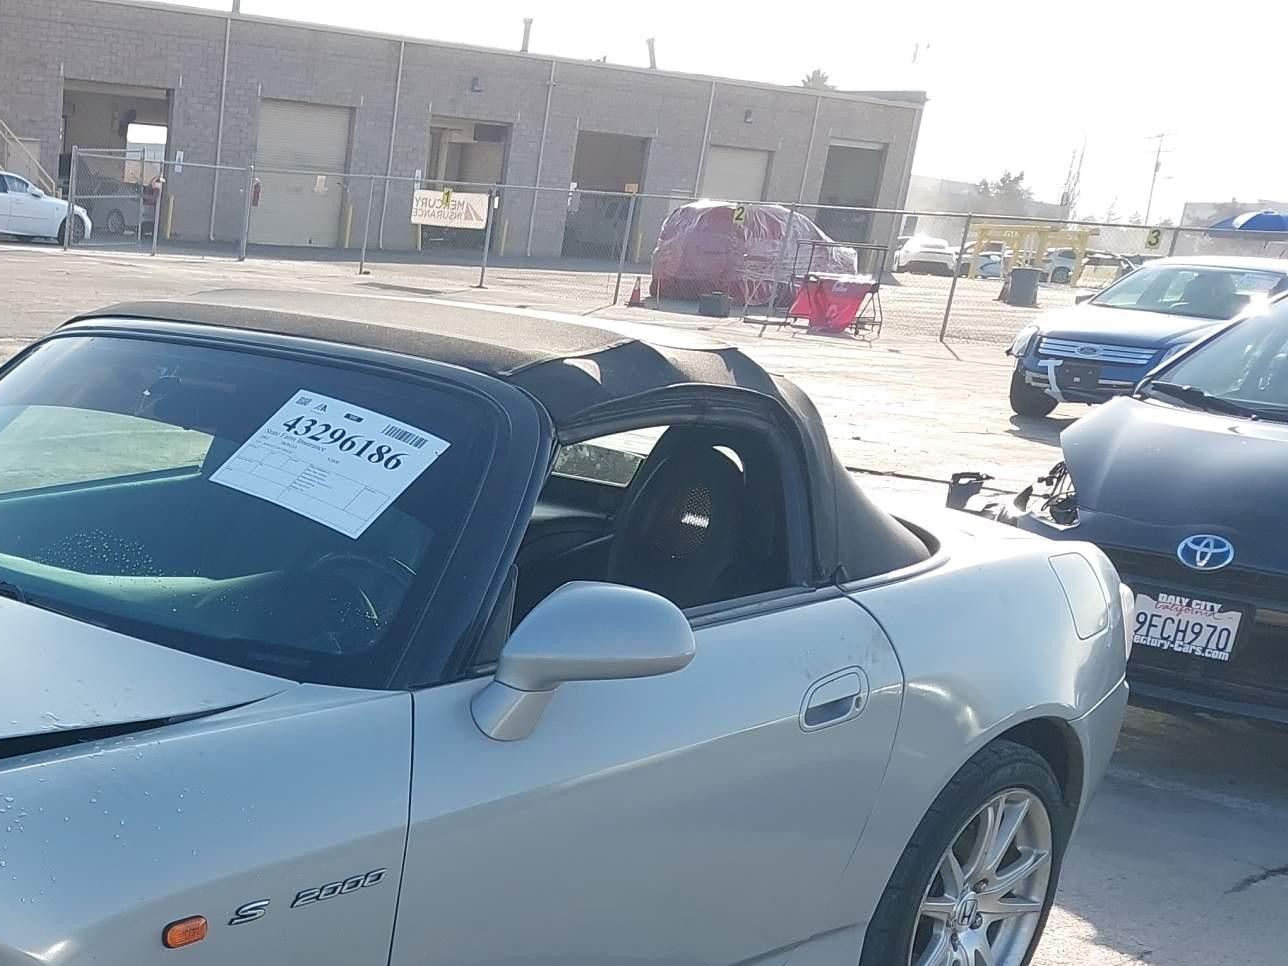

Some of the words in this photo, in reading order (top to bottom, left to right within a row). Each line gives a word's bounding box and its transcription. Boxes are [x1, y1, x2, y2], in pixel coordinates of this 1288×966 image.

[735, 206, 745, 221] 2
[1148, 229, 1161, 246] 3
[282, 415, 410, 471] 43296186
[1158, 593, 1190, 606] DALY
[1191, 600, 1222, 613] CITY
[227, 898, 271, 926] S
[289, 867, 388, 909] 2000
